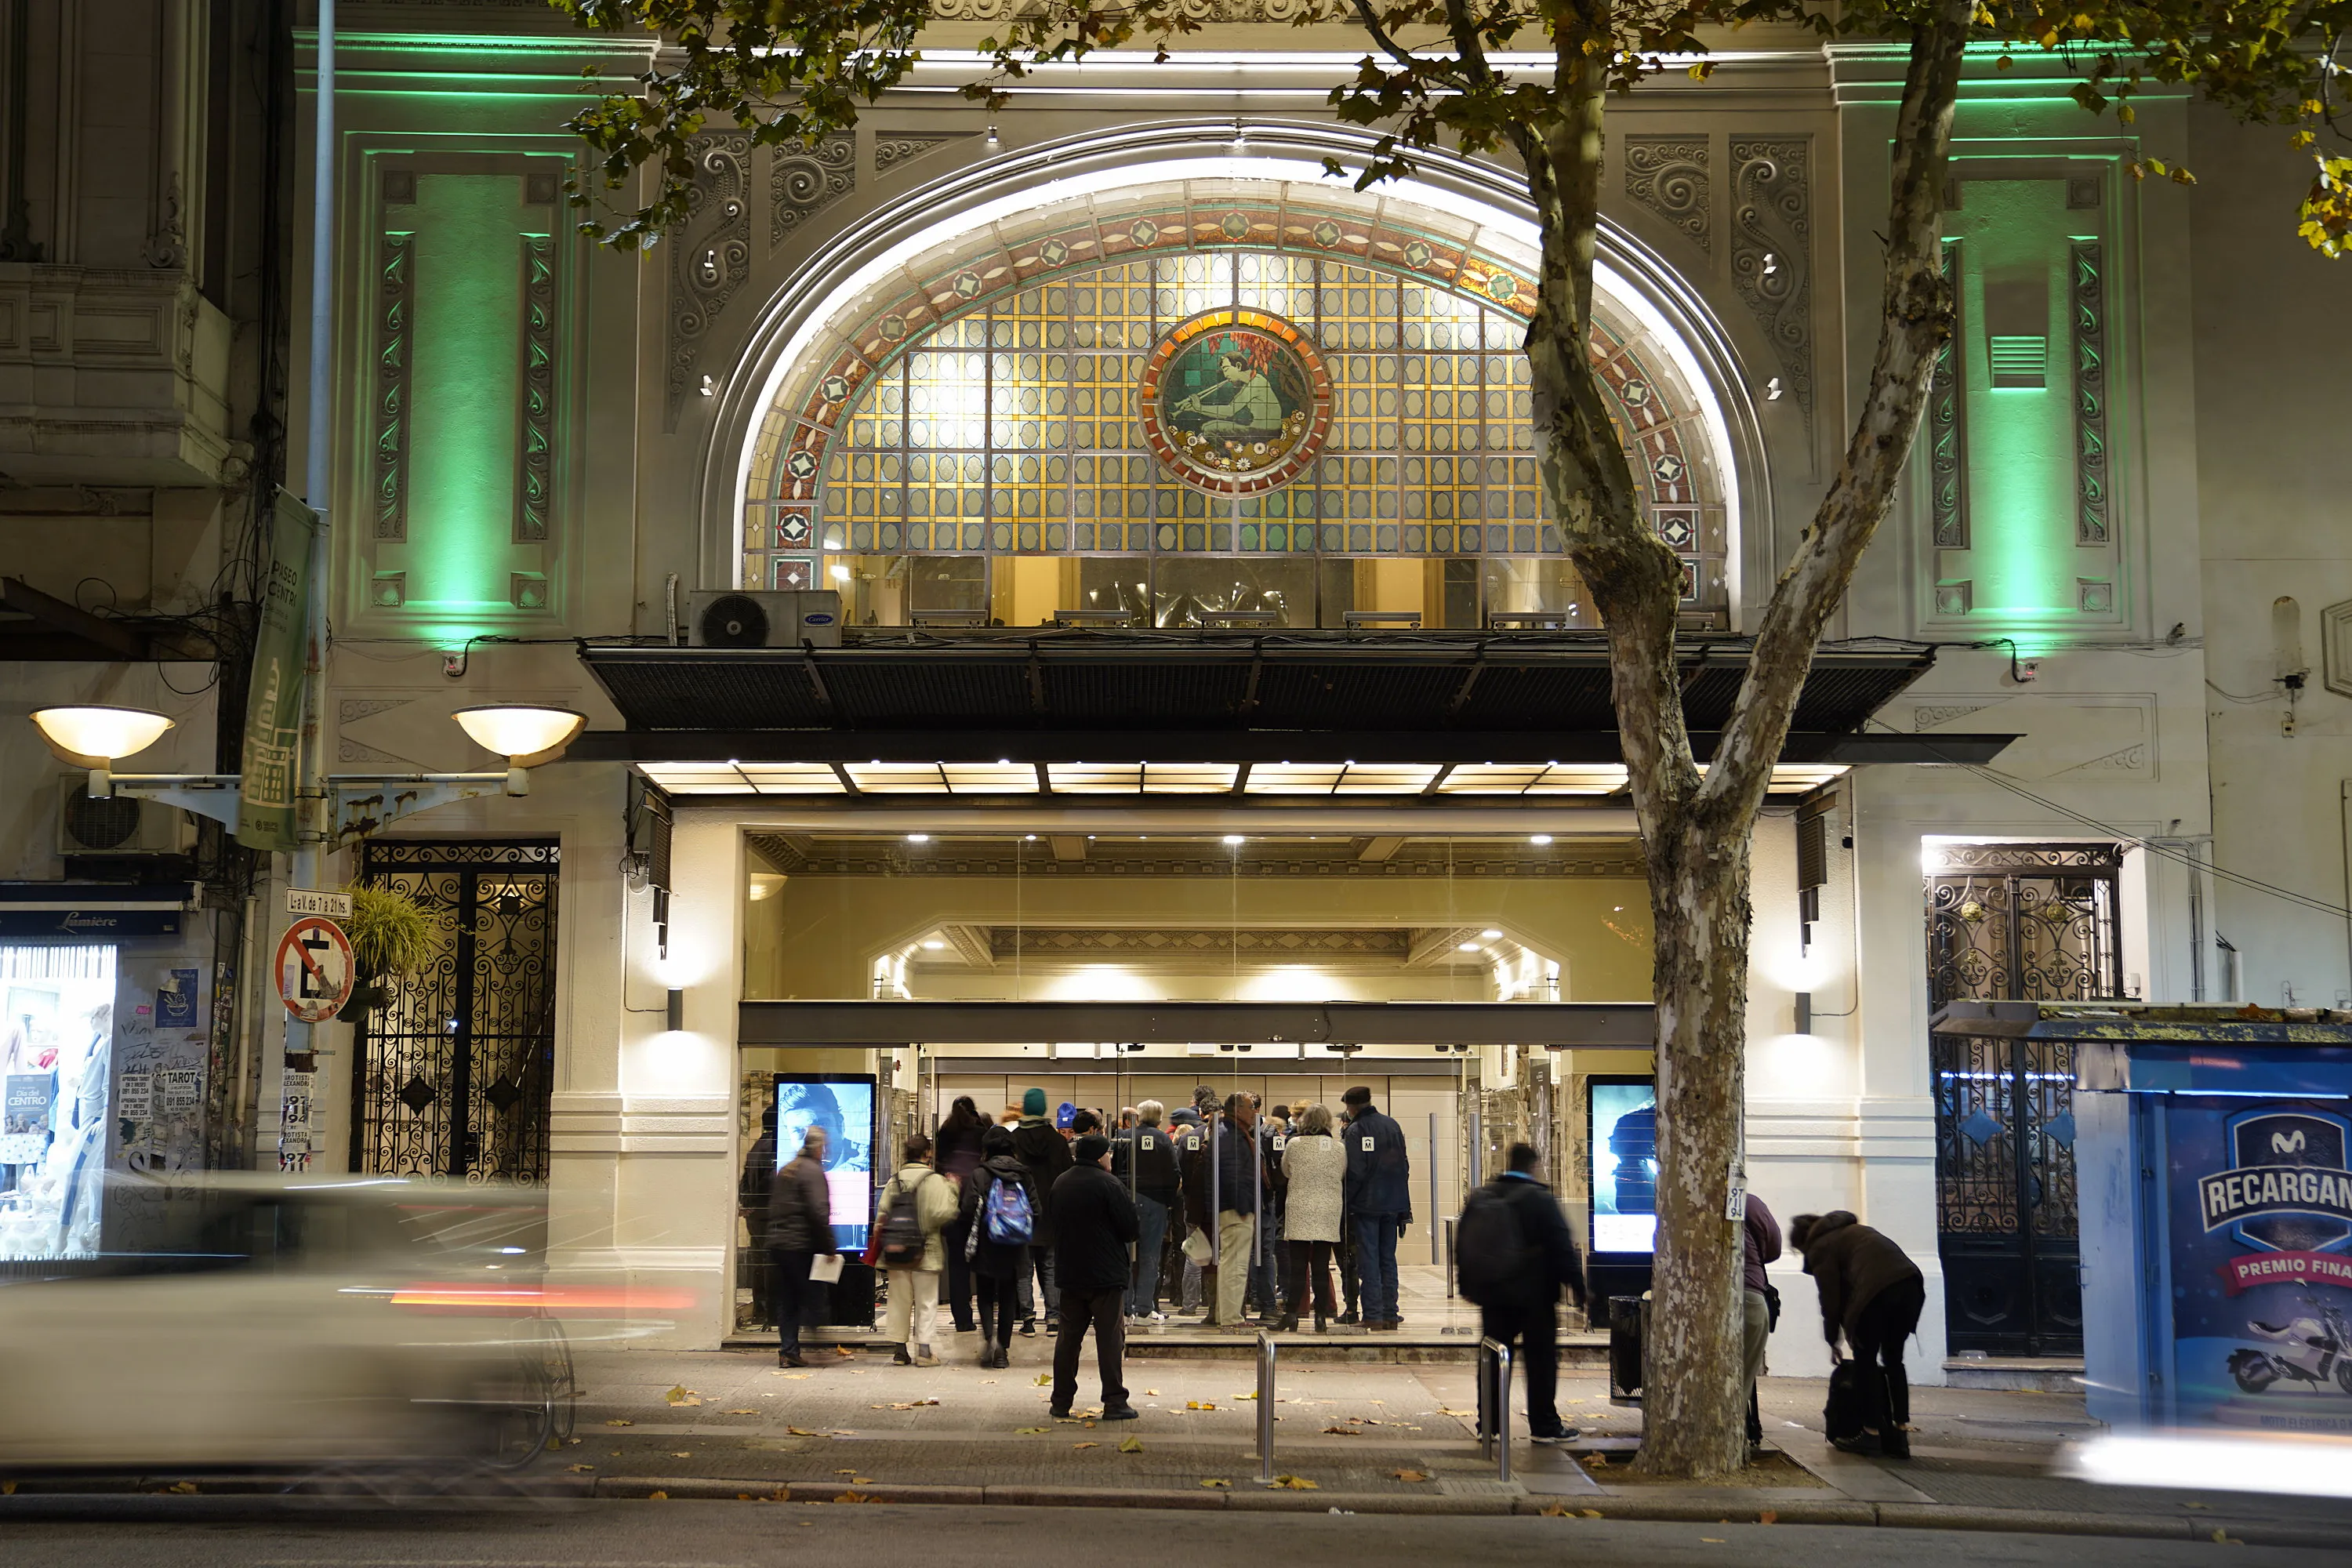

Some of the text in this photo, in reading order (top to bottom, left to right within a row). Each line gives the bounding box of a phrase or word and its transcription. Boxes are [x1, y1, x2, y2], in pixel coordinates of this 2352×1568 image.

[271, 560, 297, 586] PASEO
[267, 581, 297, 608] CENTR
[308, 896, 316, 911] de
[318, 897, 322, 911] 7
[324, 901, 328, 912] a
[330, 898, 337, 913] 21
[56, 912, 117, 934] Lumière
[168, 1072, 195, 1083] TAROT
[8, 1097, 46, 1105] CENTRO
[166, 1097, 194, 1105] 091 855 234
[2238, 1259, 2306, 1279] PREMIO
